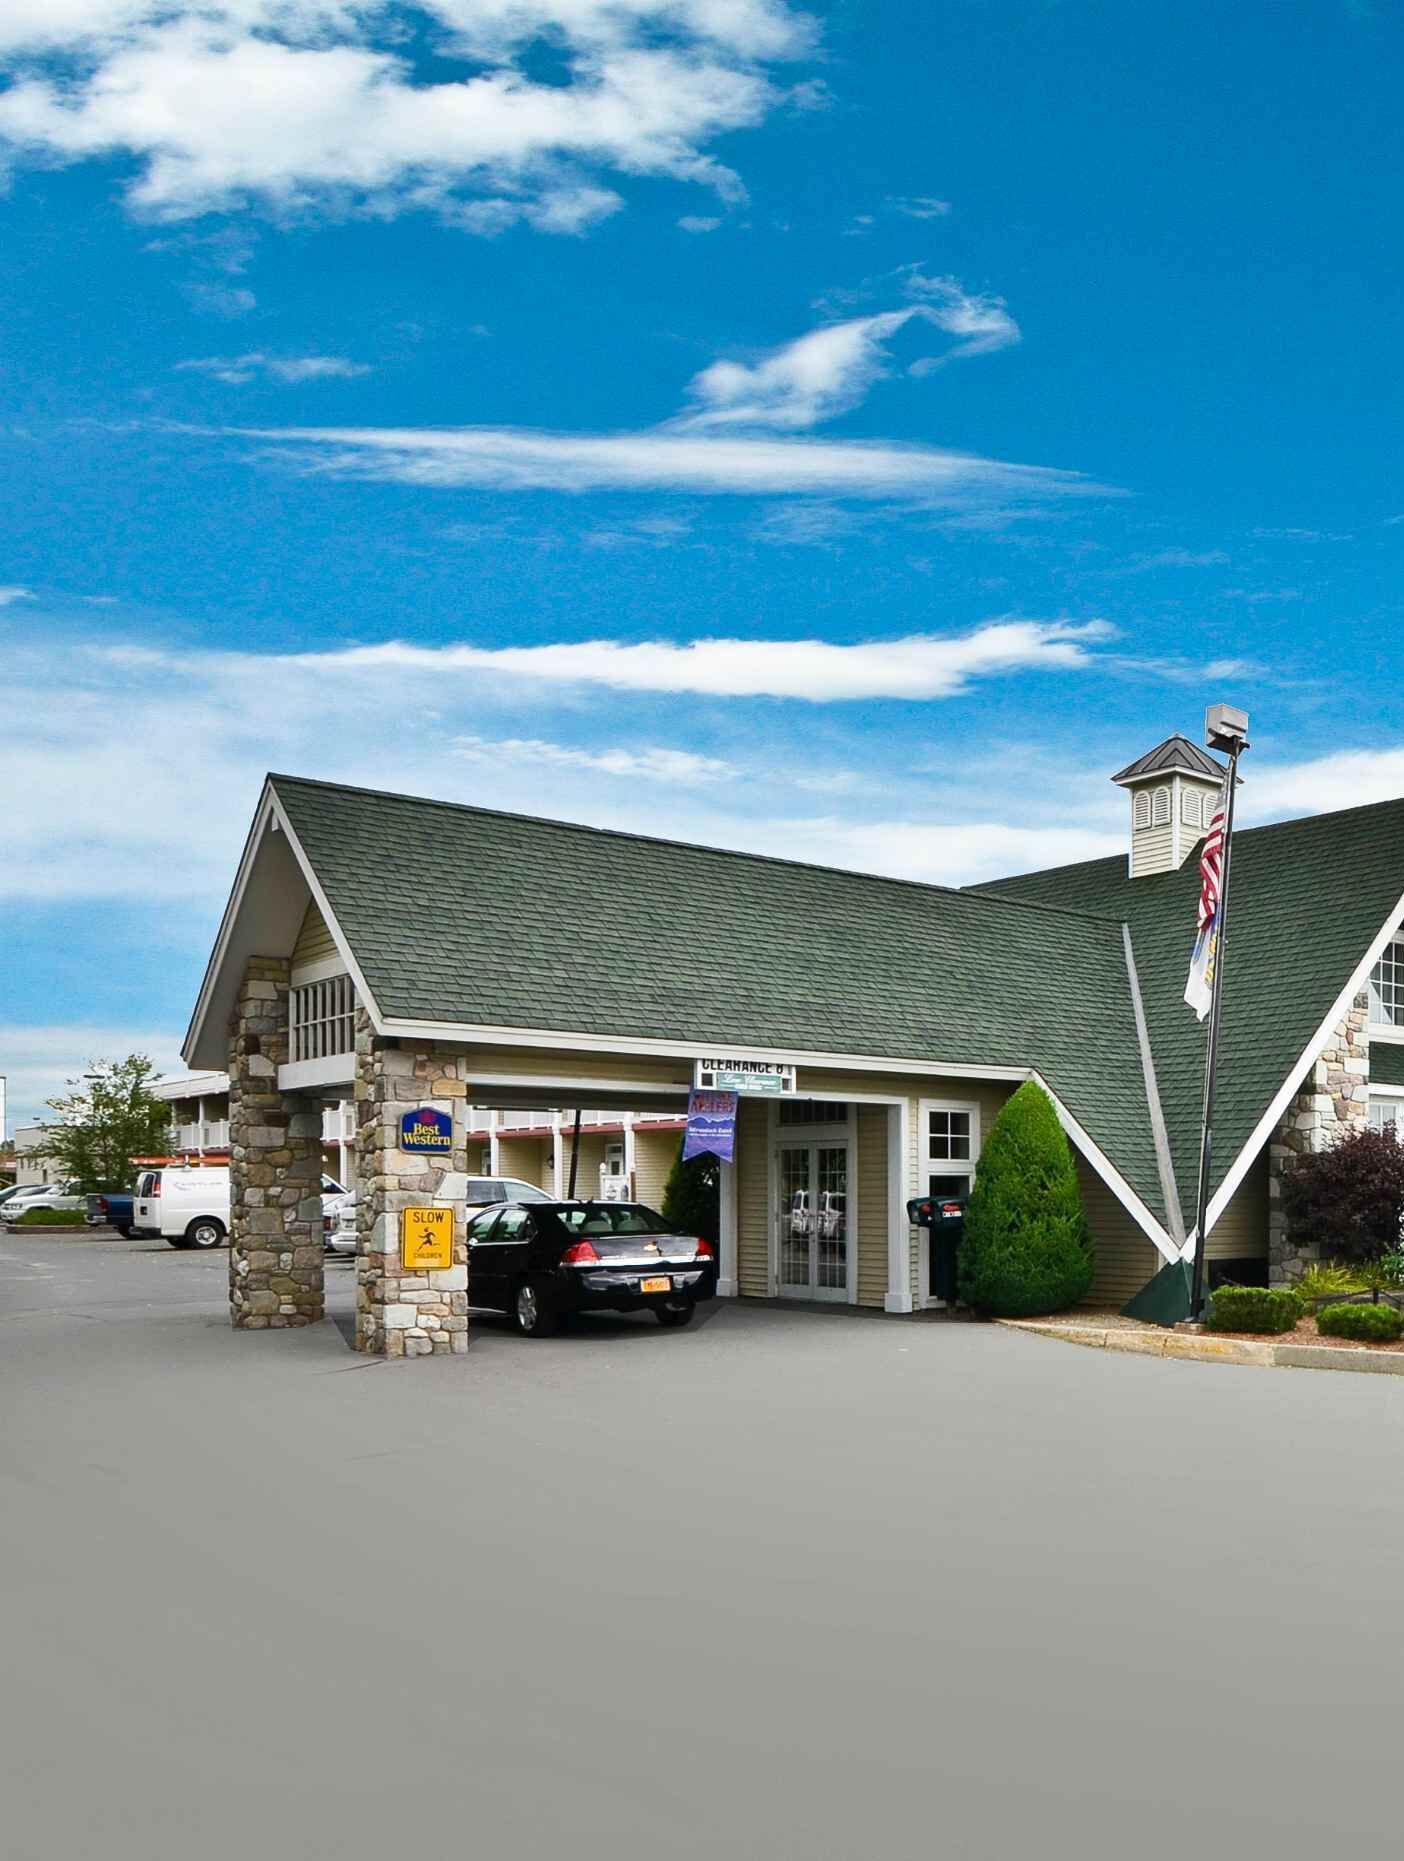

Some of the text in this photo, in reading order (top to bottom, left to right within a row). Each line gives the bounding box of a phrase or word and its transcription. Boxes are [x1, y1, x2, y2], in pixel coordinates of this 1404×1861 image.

[413, 1123, 440, 1135] Best
[402, 1132, 451, 1145] Western
[412, 1211, 444, 1223] SLOW
